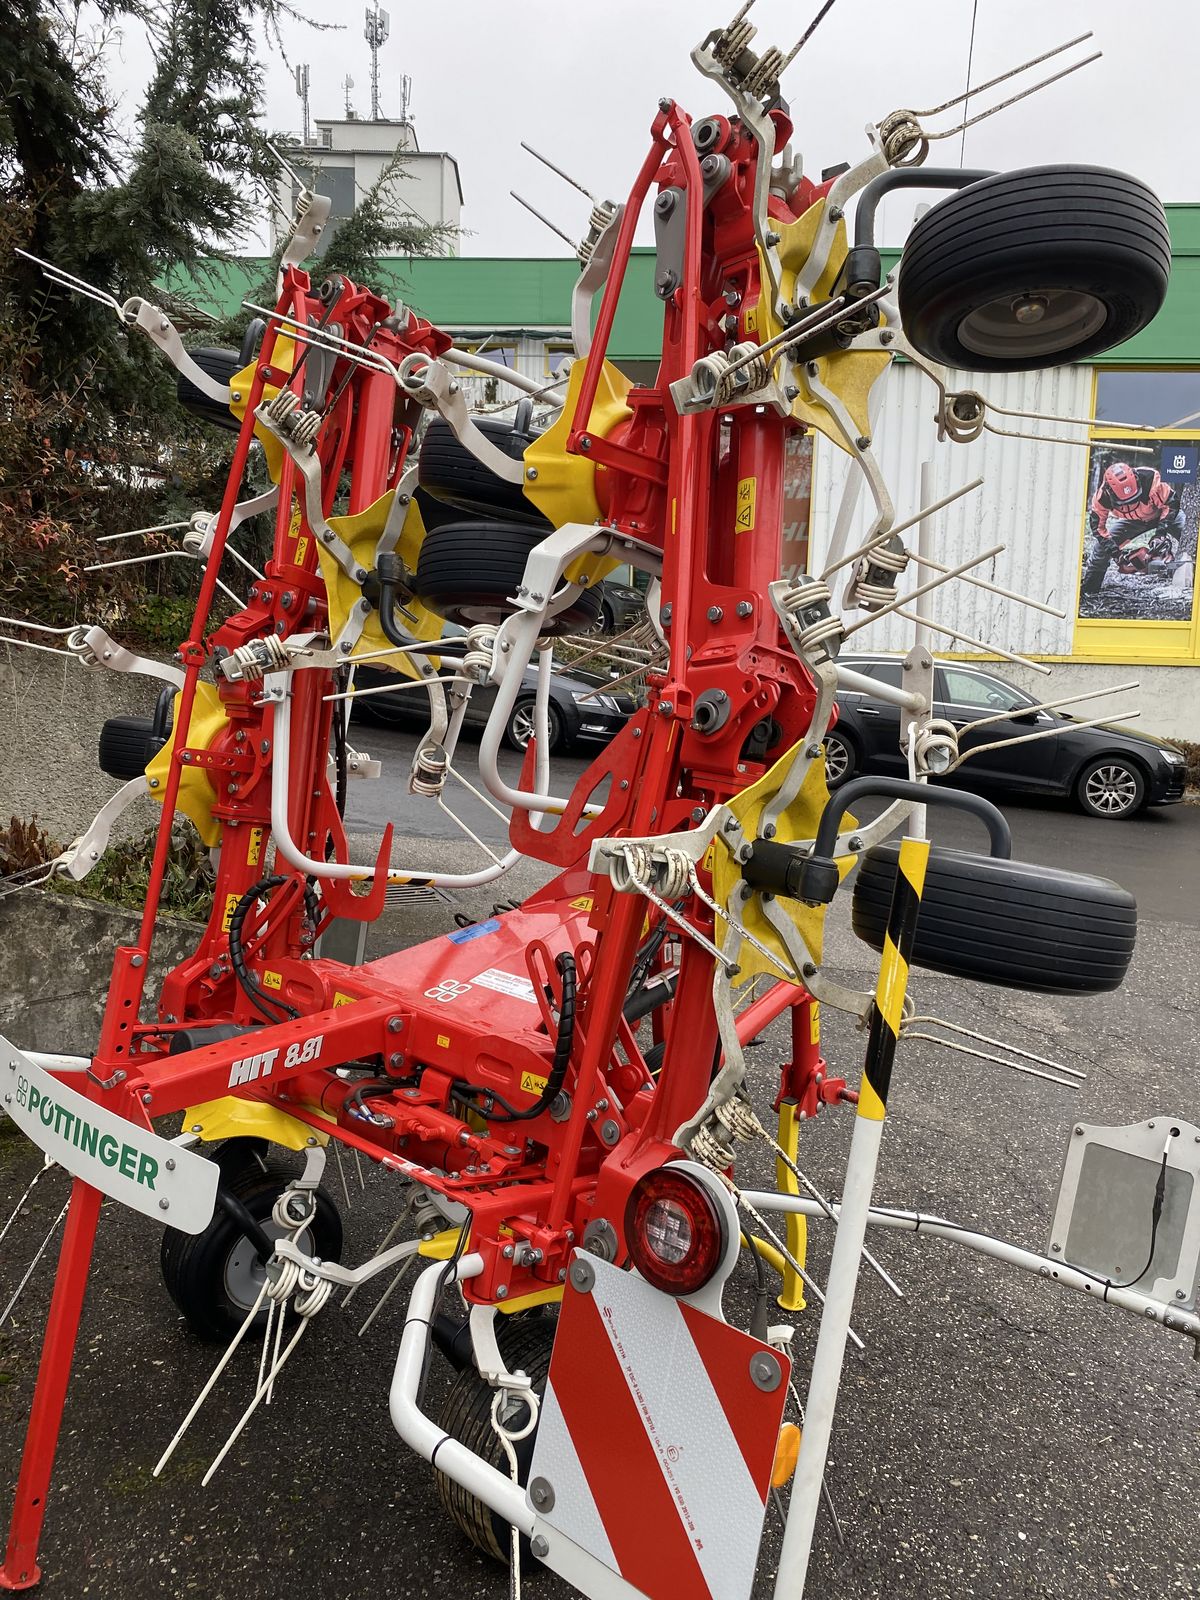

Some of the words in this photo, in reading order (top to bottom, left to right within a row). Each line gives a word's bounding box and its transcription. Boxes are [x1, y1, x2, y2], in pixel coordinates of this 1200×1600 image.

[227, 1048, 280, 1089] HIT
[284, 1034, 325, 1068] 8.81
[27, 1085, 159, 1191] PÖTTINGER
